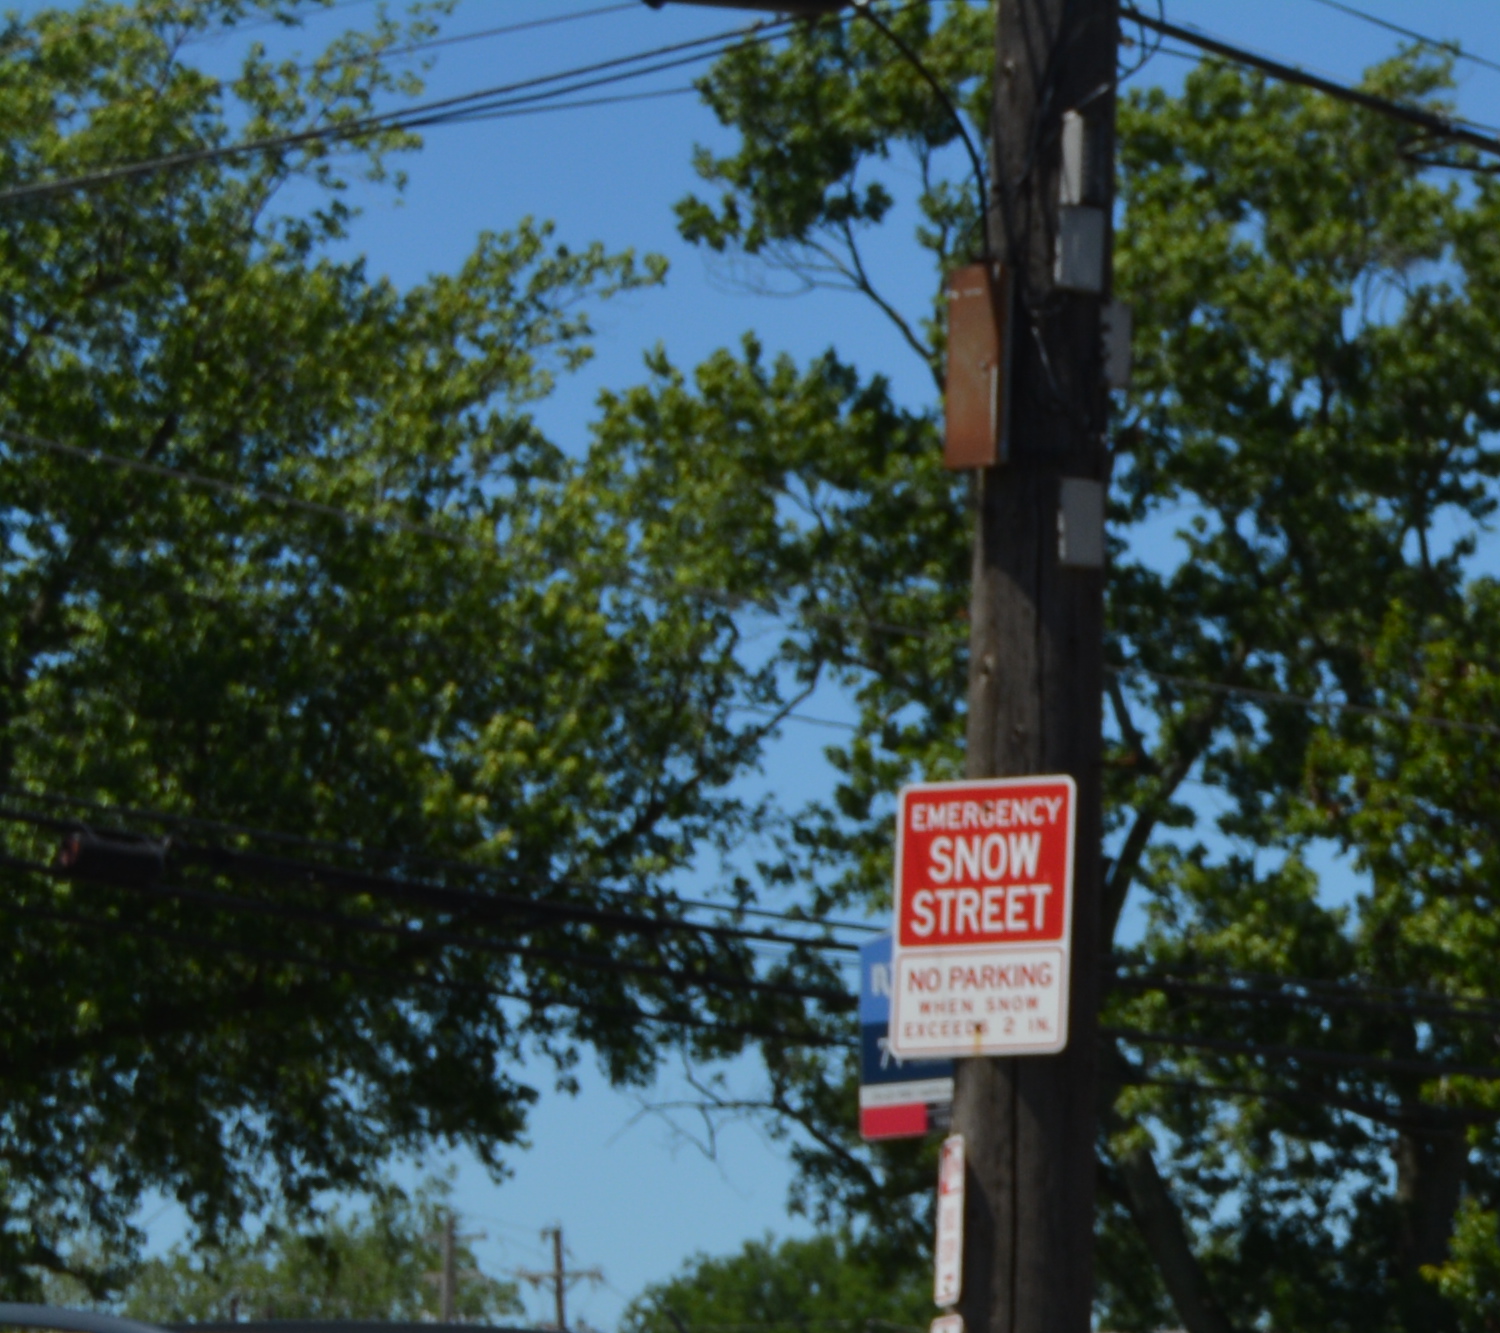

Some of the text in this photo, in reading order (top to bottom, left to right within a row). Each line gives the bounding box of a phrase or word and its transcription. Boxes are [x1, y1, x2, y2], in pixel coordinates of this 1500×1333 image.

[910, 796, 1063, 832] EMERGENCY
[928, 831, 1042, 884] SNOW
[910, 884, 1053, 938] STREET
[908, 967, 942, 993] NO
[949, 961, 1053, 991] PARKING
[919, 996, 1039, 1015] WHEN SNOW
[1003, 1016, 1015, 1035] 2
